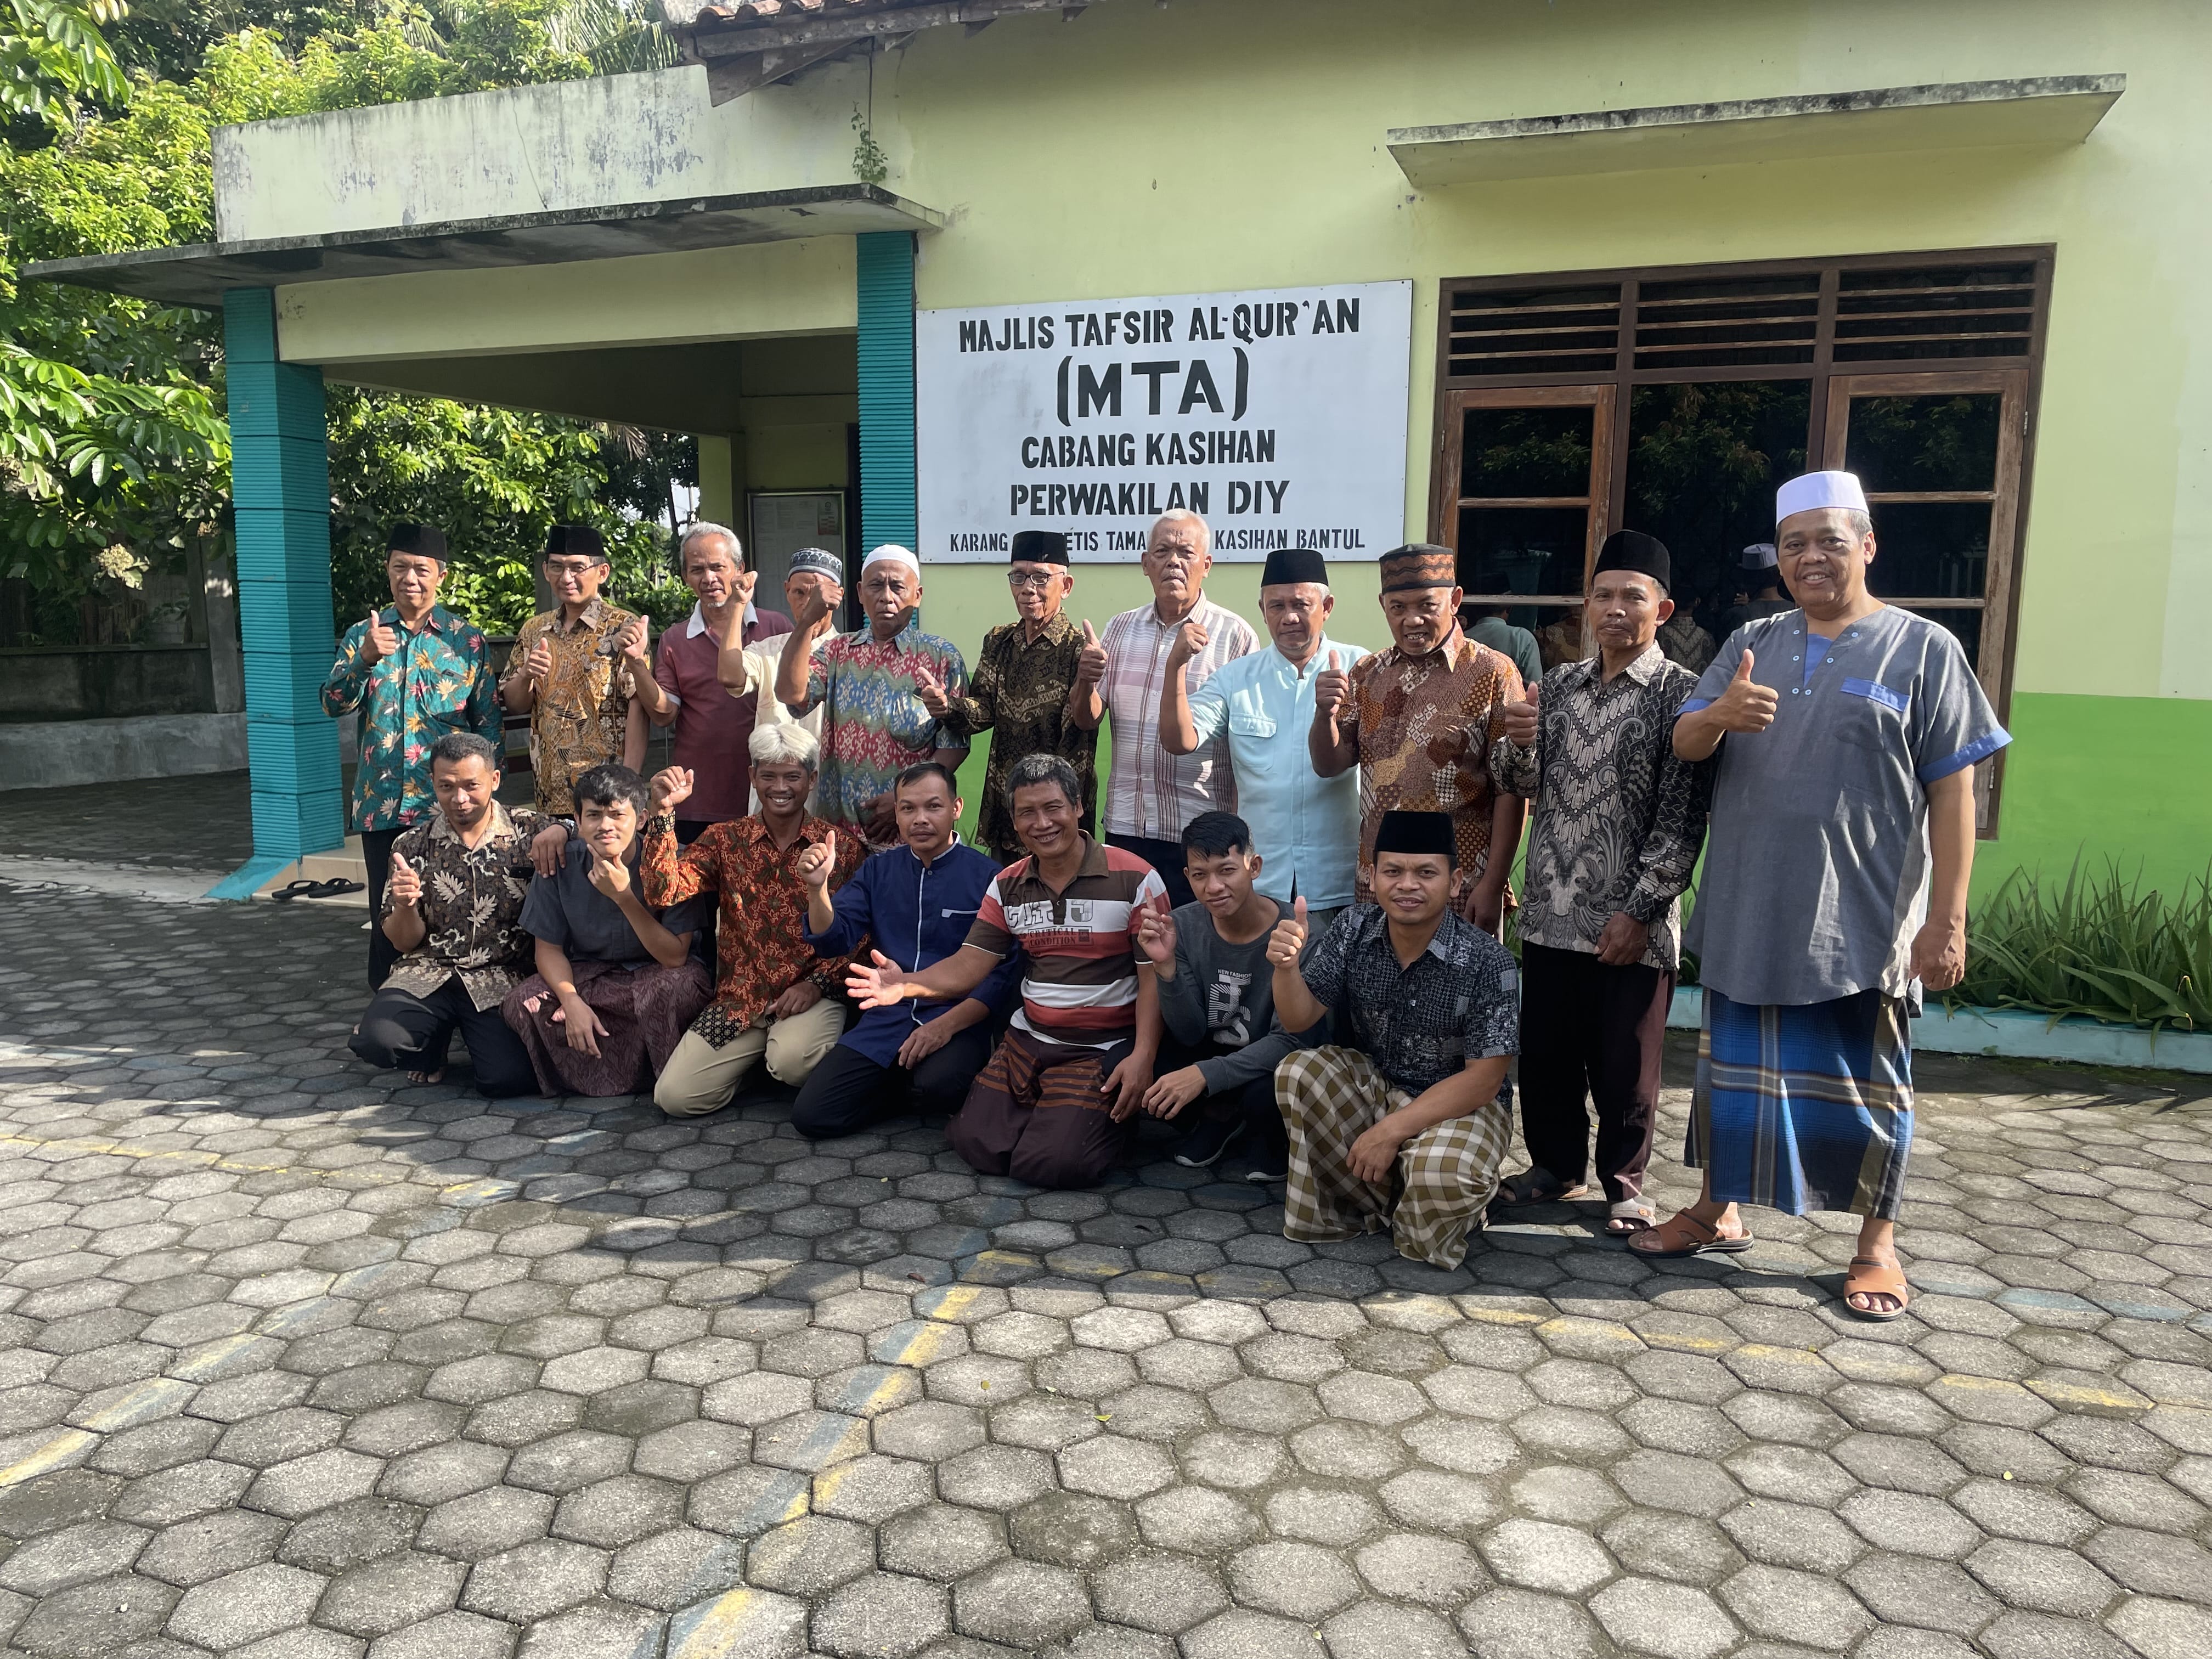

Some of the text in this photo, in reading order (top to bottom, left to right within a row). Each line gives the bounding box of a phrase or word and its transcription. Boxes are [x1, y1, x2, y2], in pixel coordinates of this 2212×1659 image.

[960, 315, 1054, 352] MAJLIS
[1065, 309, 1174, 347] TAFSIR
[1057, 347, 1249, 427] (MTA)
[1021, 429, 1276, 469] CABANG KASIHAN
[1011, 480, 1290, 516] PERWAKILAN DIY
[950, 528, 1365, 552] KARANG ETIS TAMA KASIHAN BANTUL
[1029, 928, 1076, 938] CRITICAL
[1030, 936, 1076, 946] CONDITION
